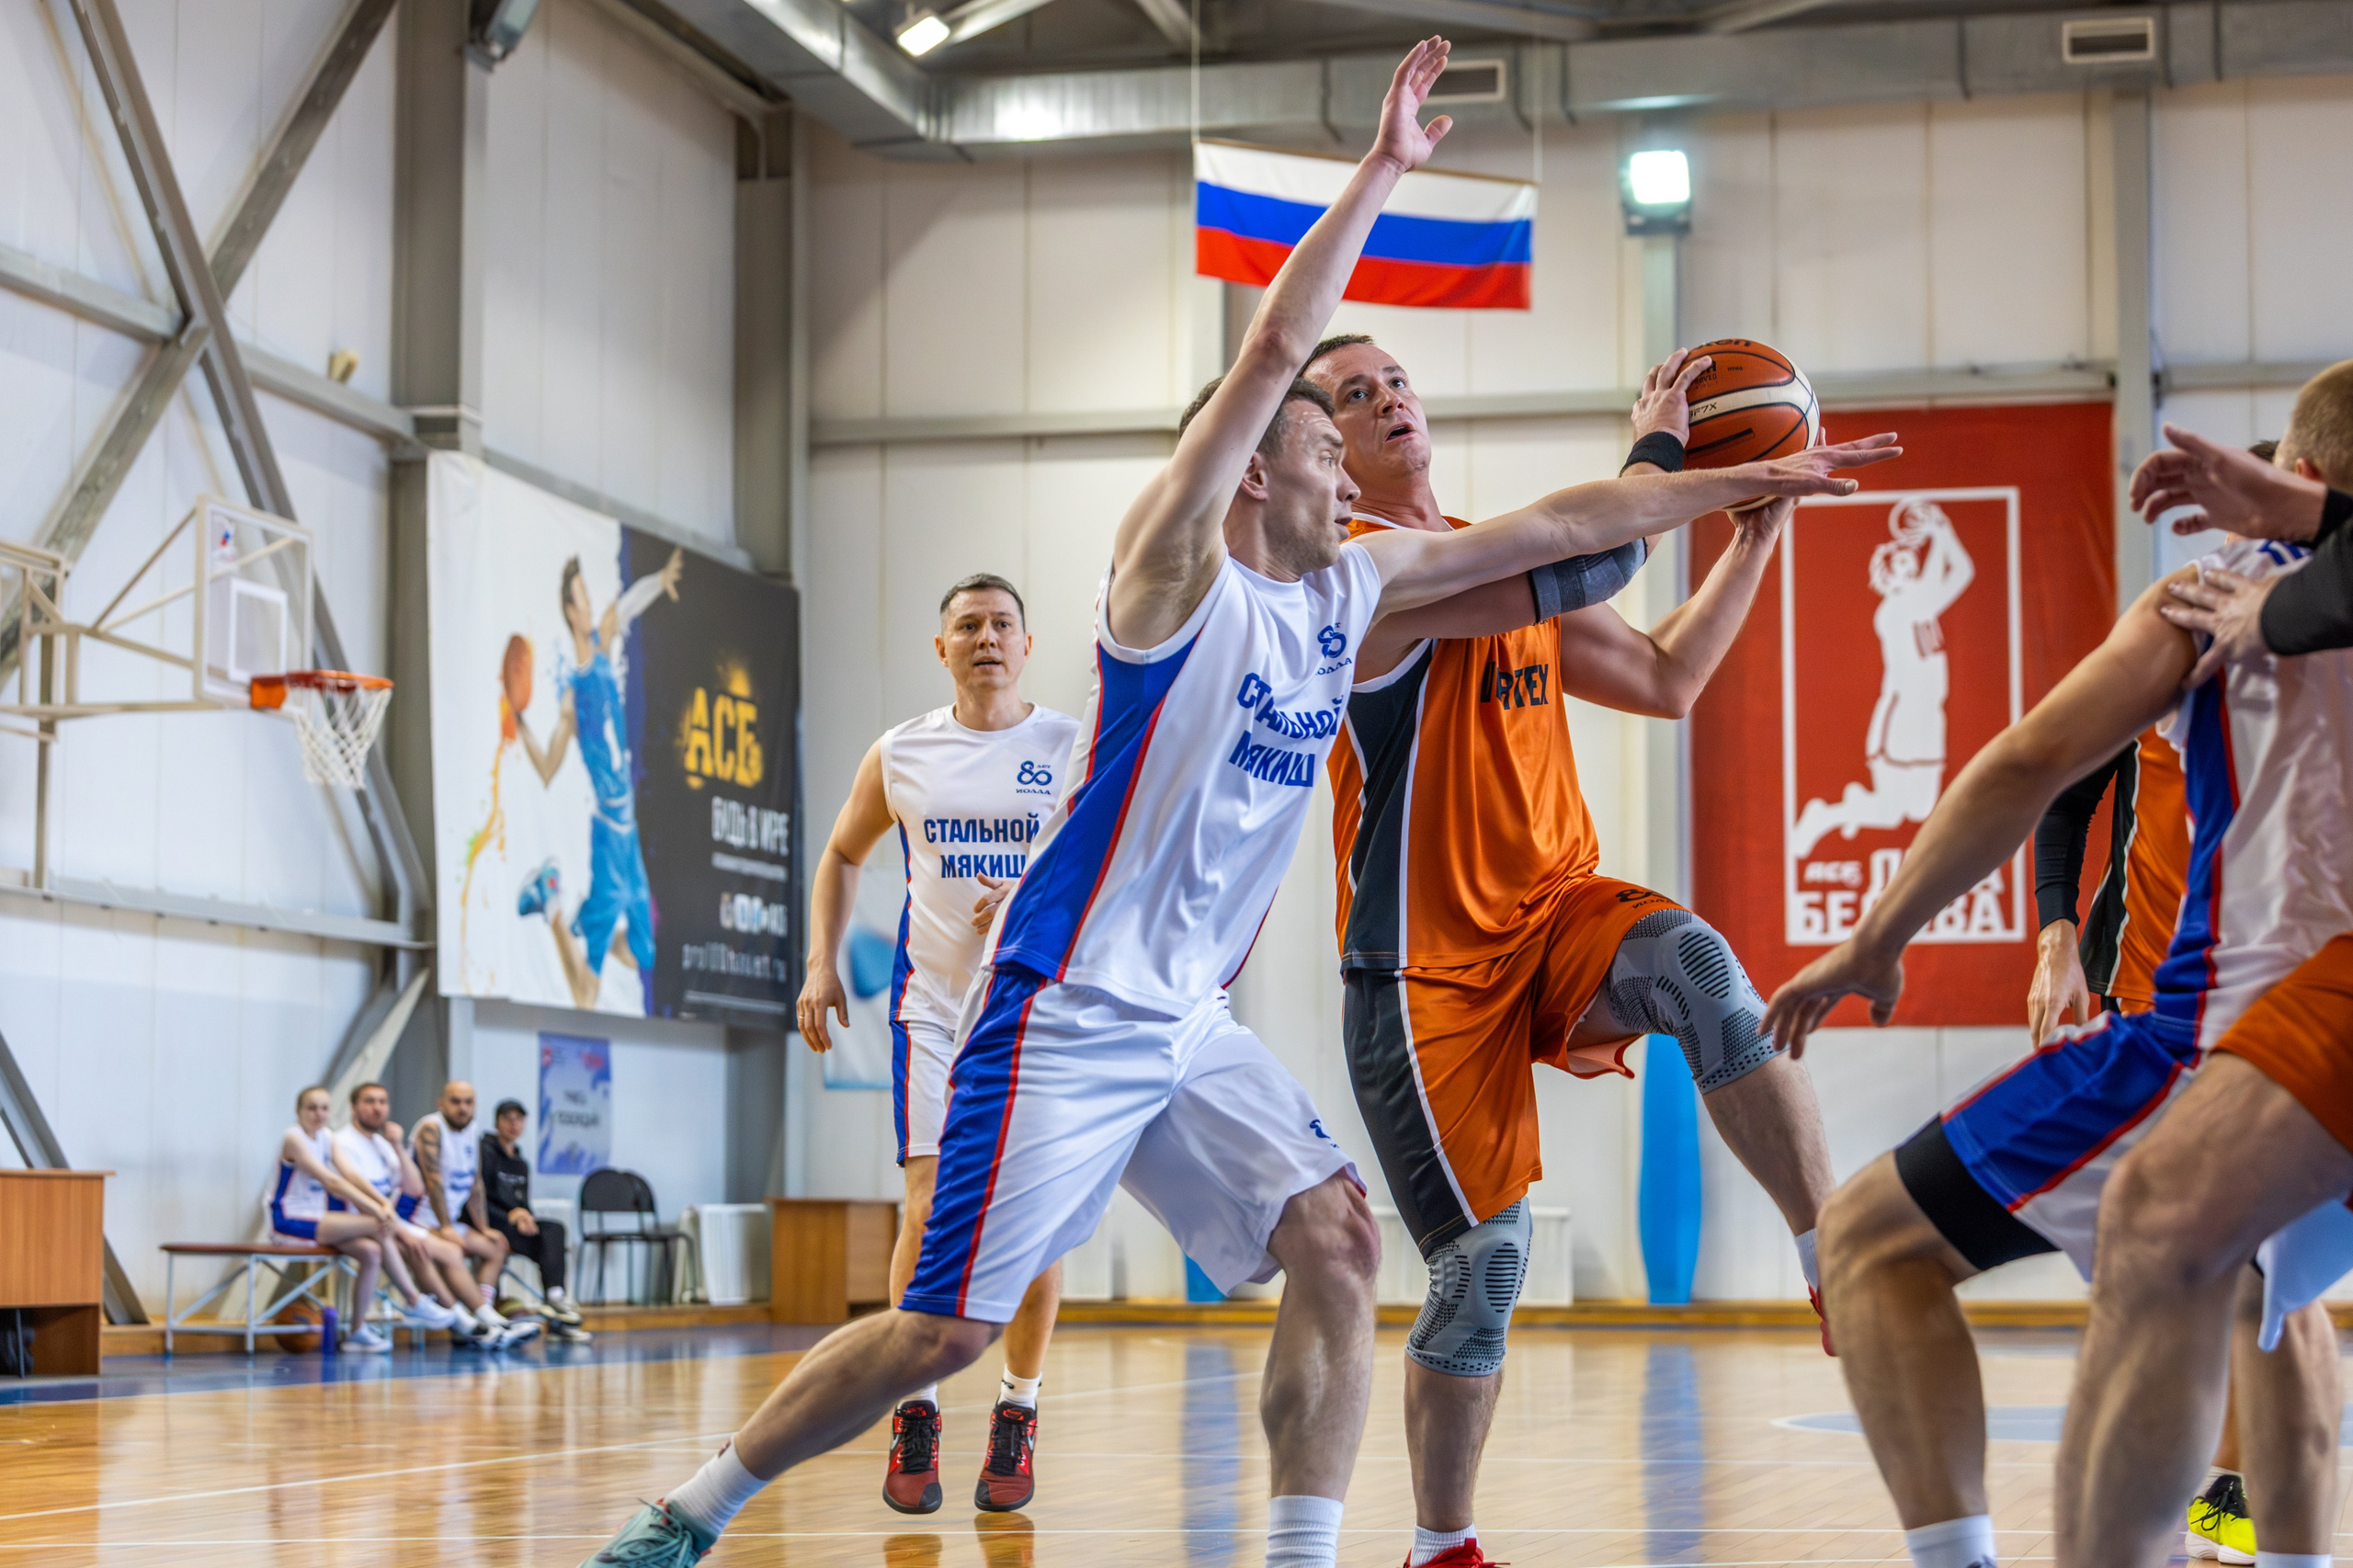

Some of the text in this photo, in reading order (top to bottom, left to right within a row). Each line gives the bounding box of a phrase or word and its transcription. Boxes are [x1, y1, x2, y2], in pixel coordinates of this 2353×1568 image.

[1228, 730, 1315, 788] МЯКИШ
[923, 812, 1040, 844] СТАЛЬНОЙ
[939, 854, 1026, 879] МЯКИШ
[1794, 890, 2005, 936] БЕВА
